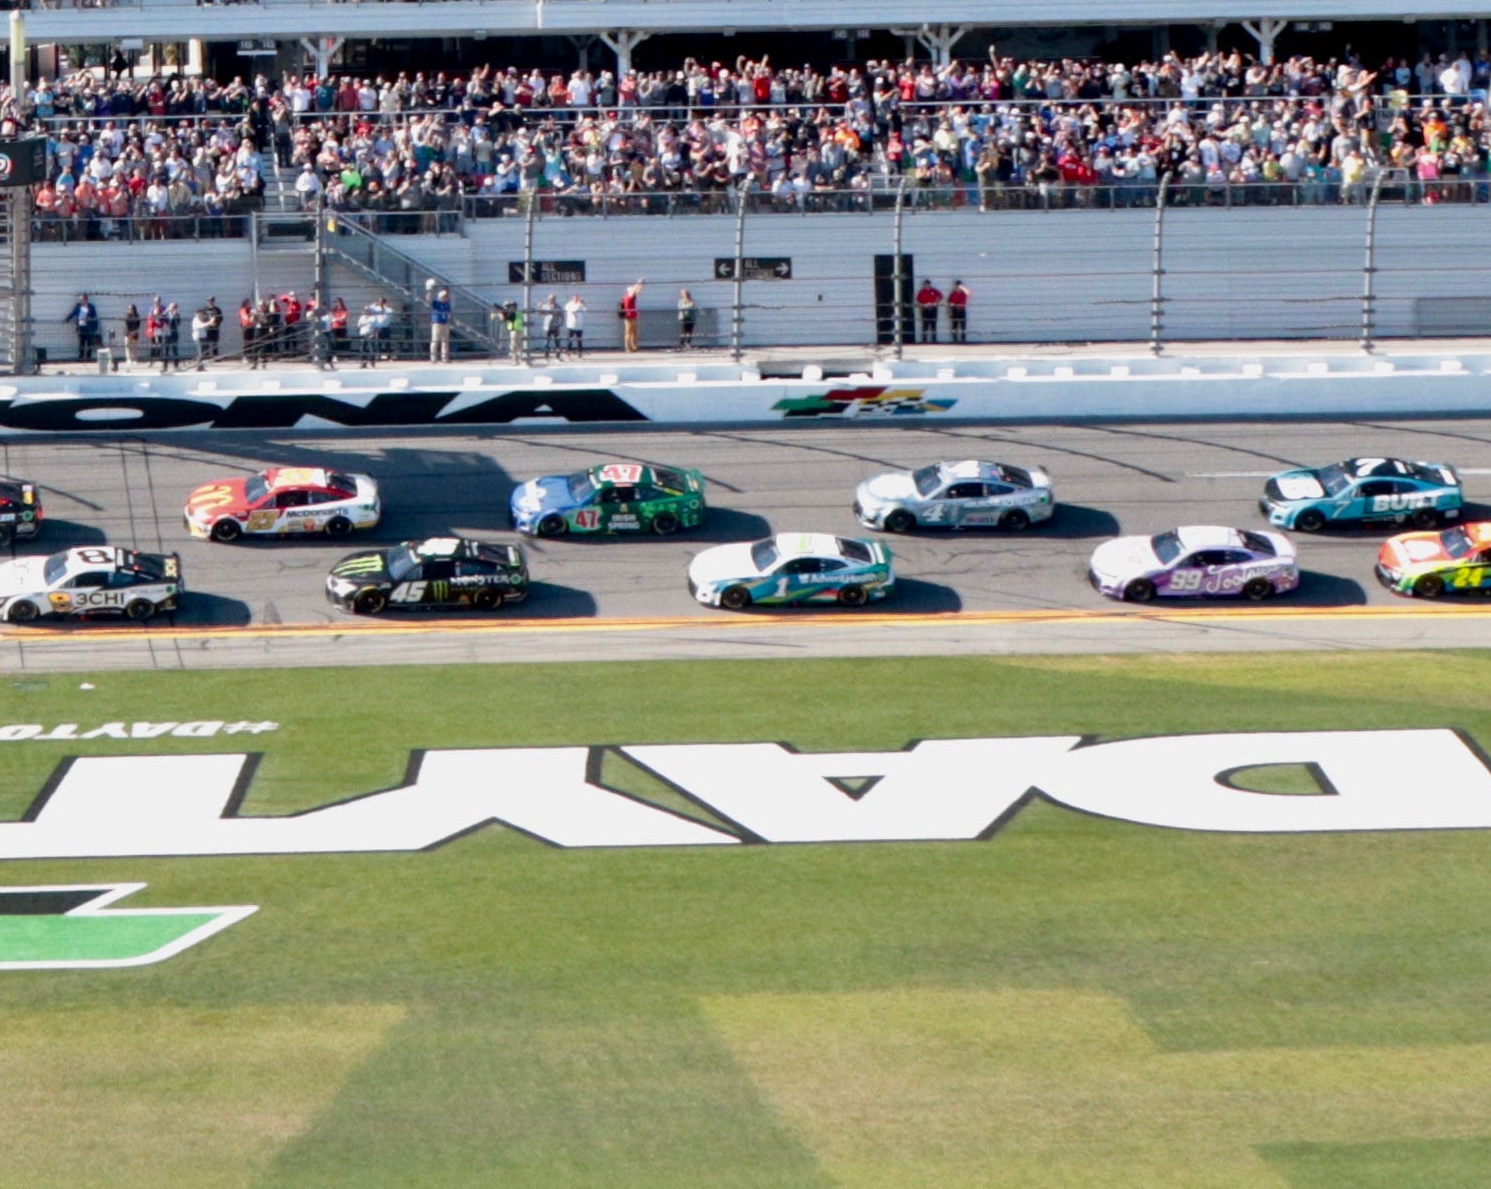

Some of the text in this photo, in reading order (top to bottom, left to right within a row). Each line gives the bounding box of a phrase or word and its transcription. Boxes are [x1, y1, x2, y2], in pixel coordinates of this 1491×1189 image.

[541, 262, 555, 272] ALL
[540, 271, 581, 282] SECTIONS
[922, 503, 945, 522] 4
[1330, 501, 1350, 519] 7
[574, 510, 599, 530] 47
[76, 548, 115, 566] 8
[449, 573, 509, 587] MONSTER
[1169, 569, 1203, 590] 99
[1452, 567, 1485, 588] 24
[389, 581, 428, 602] 45
[774, 577, 790, 598] 1
[75, 592, 125, 607] 3CHI
